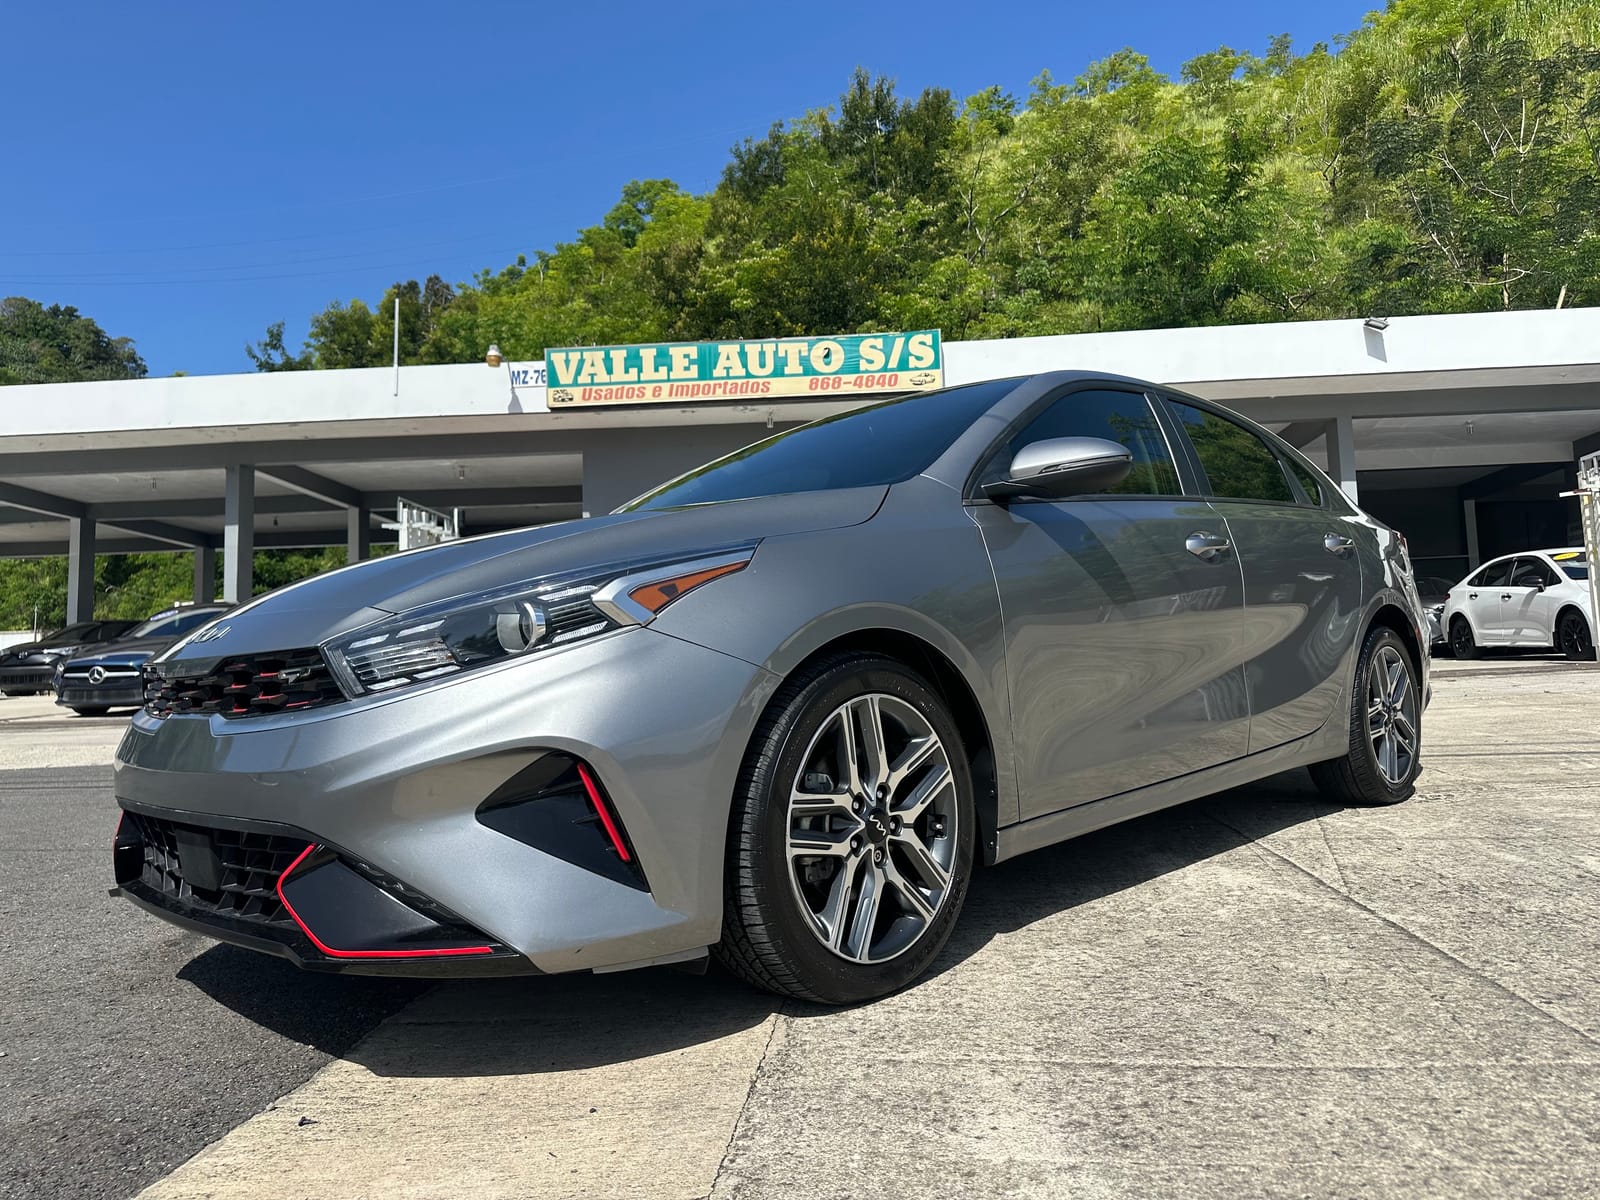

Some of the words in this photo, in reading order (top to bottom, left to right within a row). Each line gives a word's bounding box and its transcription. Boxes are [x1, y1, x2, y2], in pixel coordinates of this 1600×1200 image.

[551, 345, 698, 384] VALLE
[713, 340, 845, 377] AUTO
[859, 334, 935, 371] S/S
[581, 385, 647, 402] Usados
[652, 385, 662, 398] e
[668, 380, 771, 397] Importados
[809, 373, 898, 391] 868-4840
